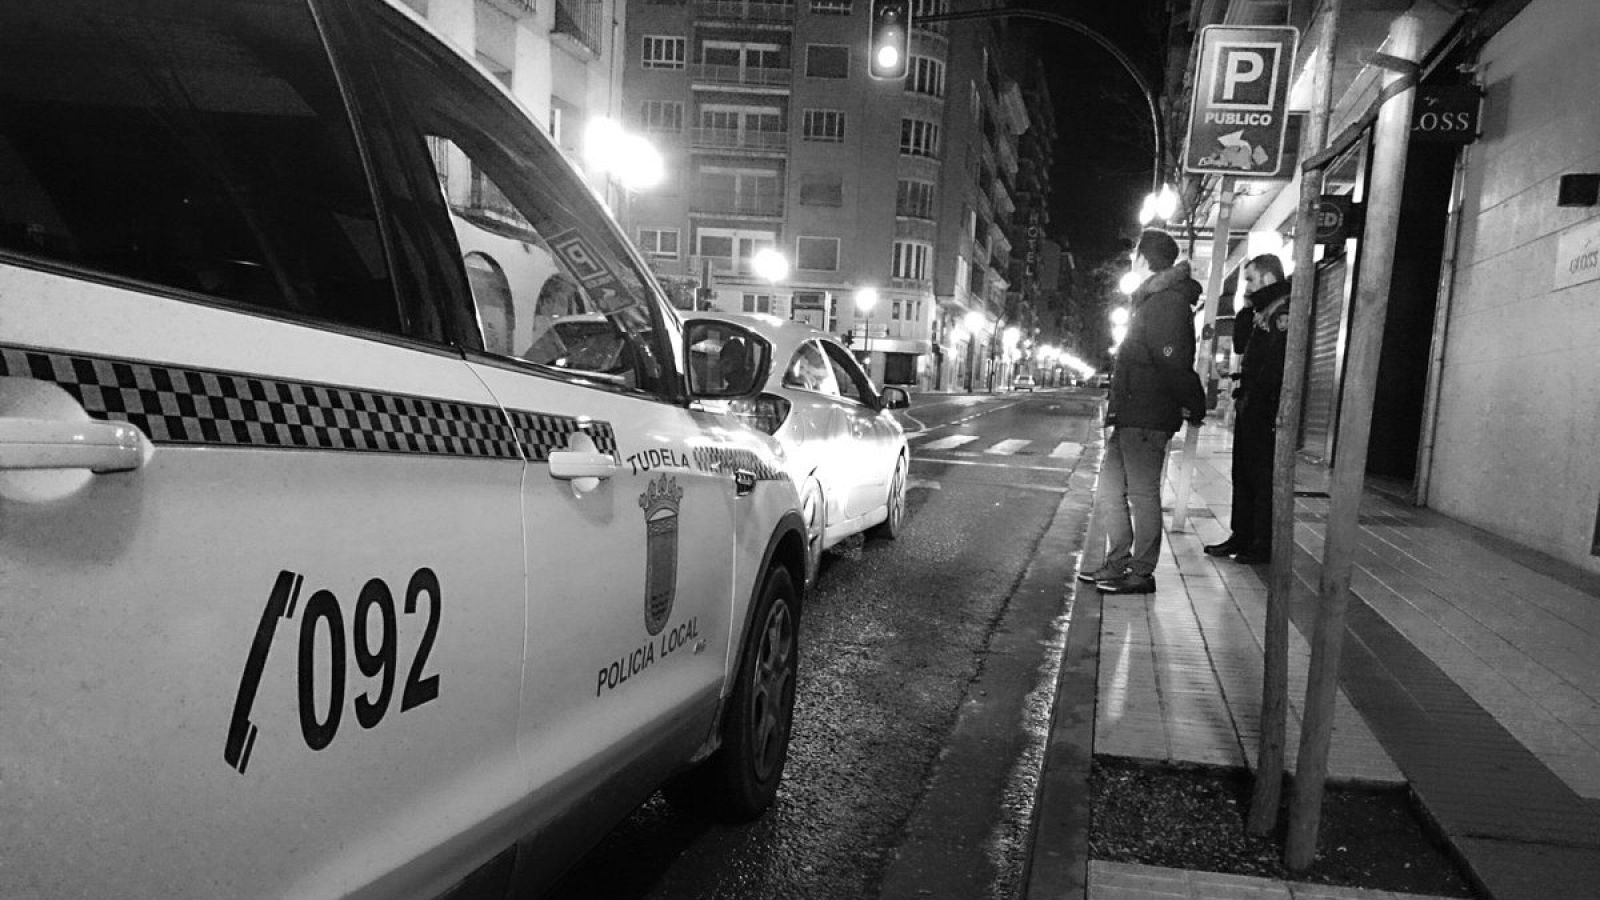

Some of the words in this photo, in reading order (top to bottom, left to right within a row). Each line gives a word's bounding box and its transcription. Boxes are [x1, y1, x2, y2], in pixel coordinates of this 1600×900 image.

[1222, 51, 1264, 100] P
[1204, 112, 1272, 126] PUBLICO
[1026, 211, 1039, 276] HOTEL
[626, 448, 691, 476] TUDELA
[297, 567, 442, 751] 092
[596, 641, 654, 697] POLICIA
[660, 616, 698, 658] LOCAL
